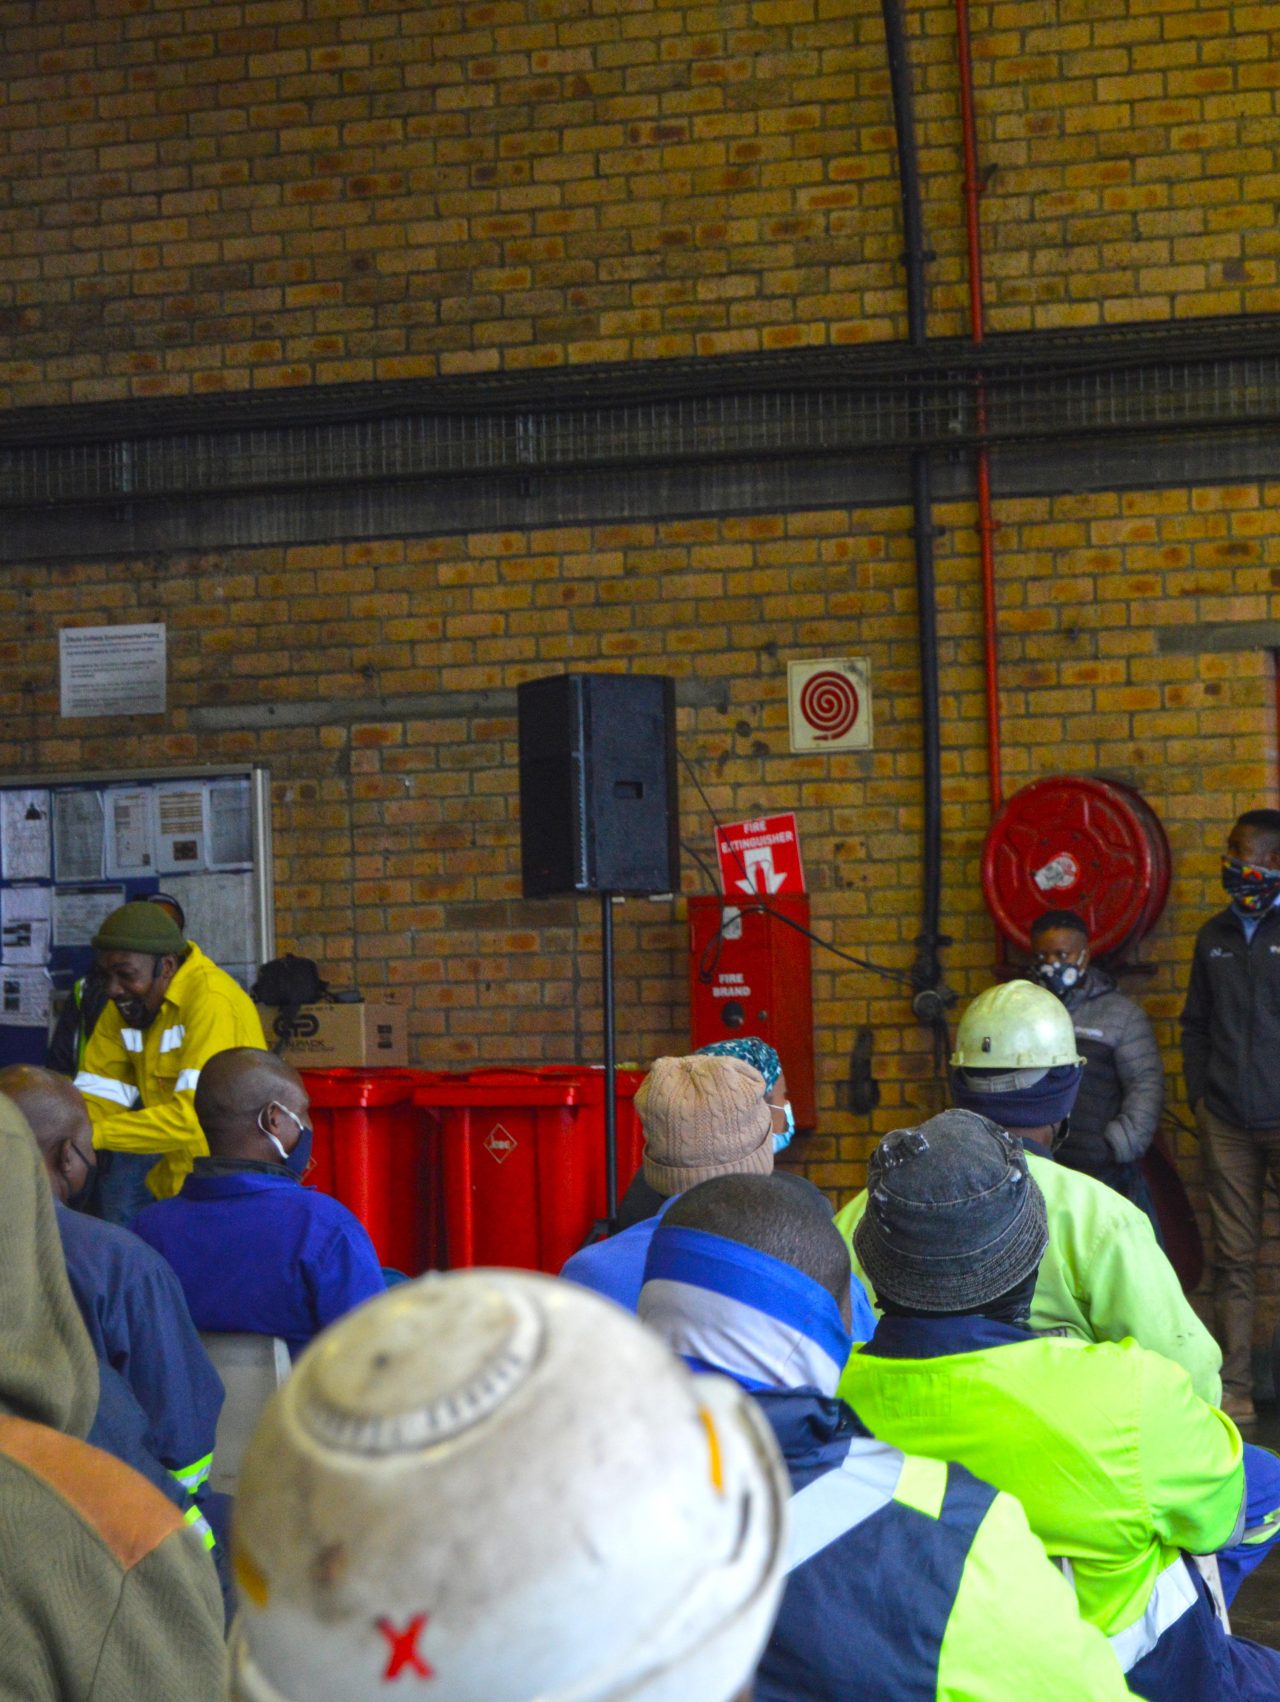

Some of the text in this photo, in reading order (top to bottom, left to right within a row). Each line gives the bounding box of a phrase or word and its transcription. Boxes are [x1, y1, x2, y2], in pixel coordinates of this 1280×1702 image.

[743, 820, 767, 834] FIRE
[718, 973, 744, 985] FIRE
[712, 985, 751, 998] BRAND
